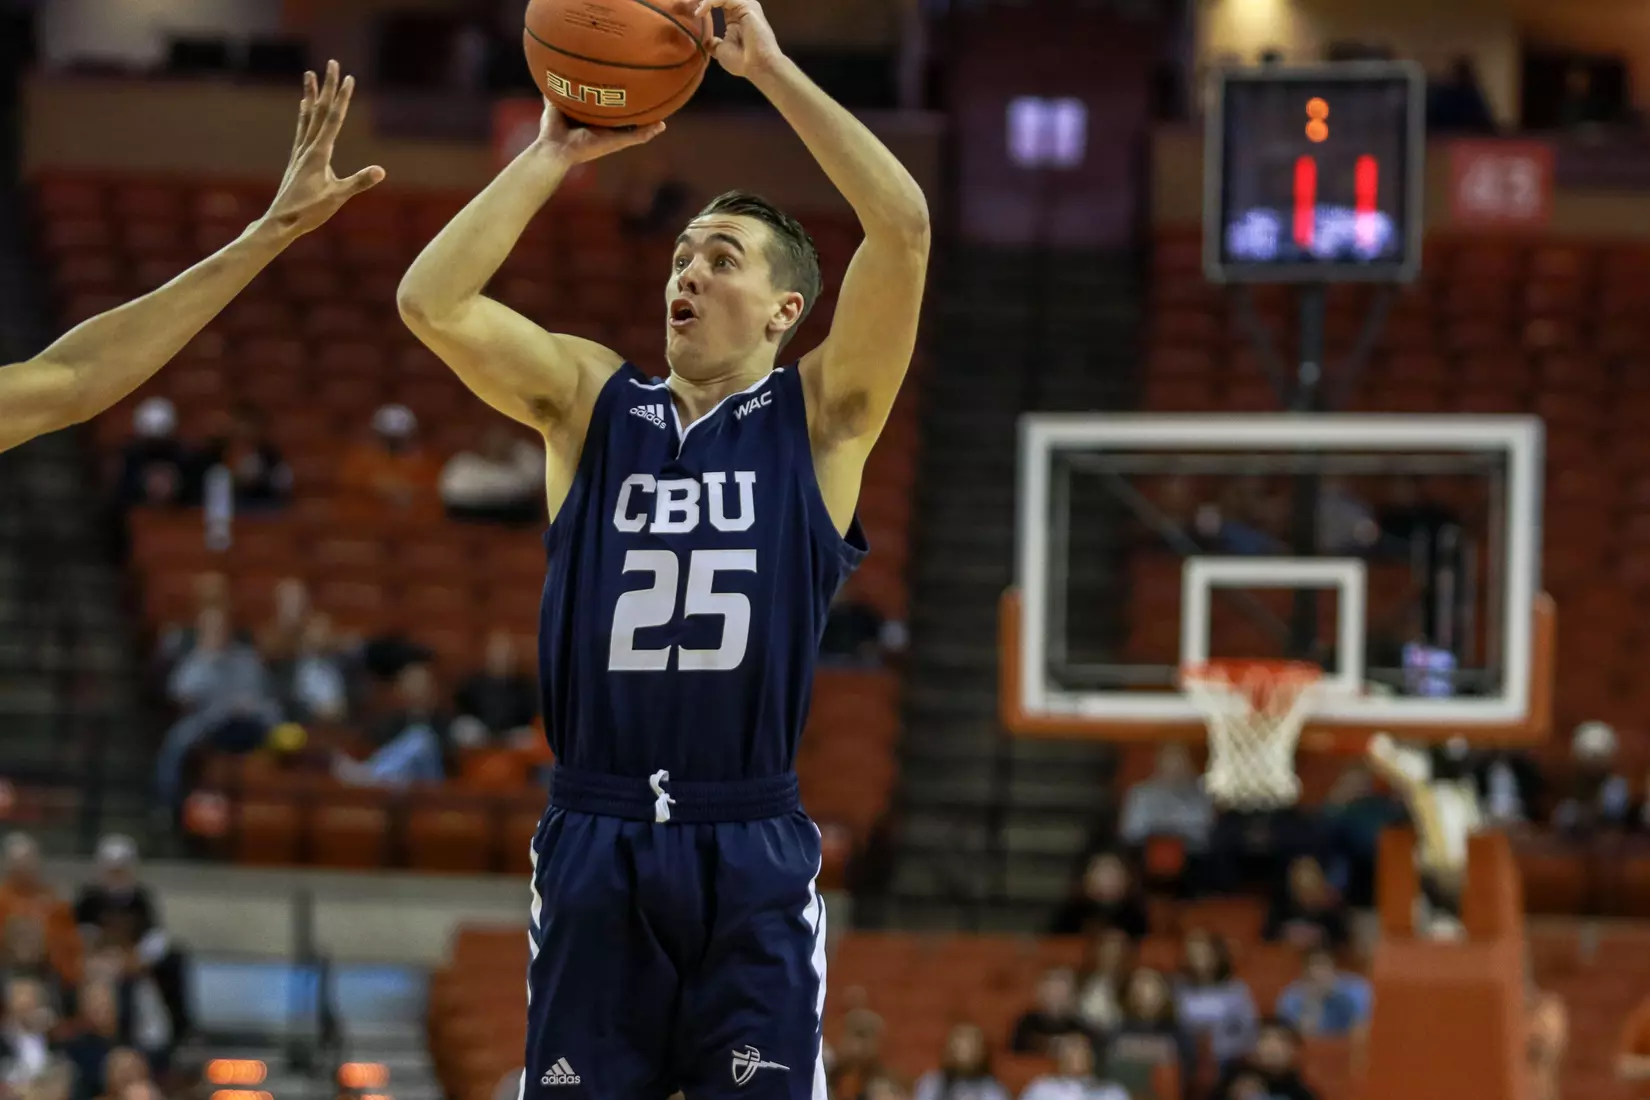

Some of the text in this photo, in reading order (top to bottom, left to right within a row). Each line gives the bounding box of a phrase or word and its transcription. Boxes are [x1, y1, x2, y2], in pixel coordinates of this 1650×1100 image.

[629, 406, 667, 429] adidas
[733, 391, 773, 420] WAC
[613, 471, 757, 534] CBU
[607, 548, 758, 671] 25
[541, 1073, 581, 1085] adidas
